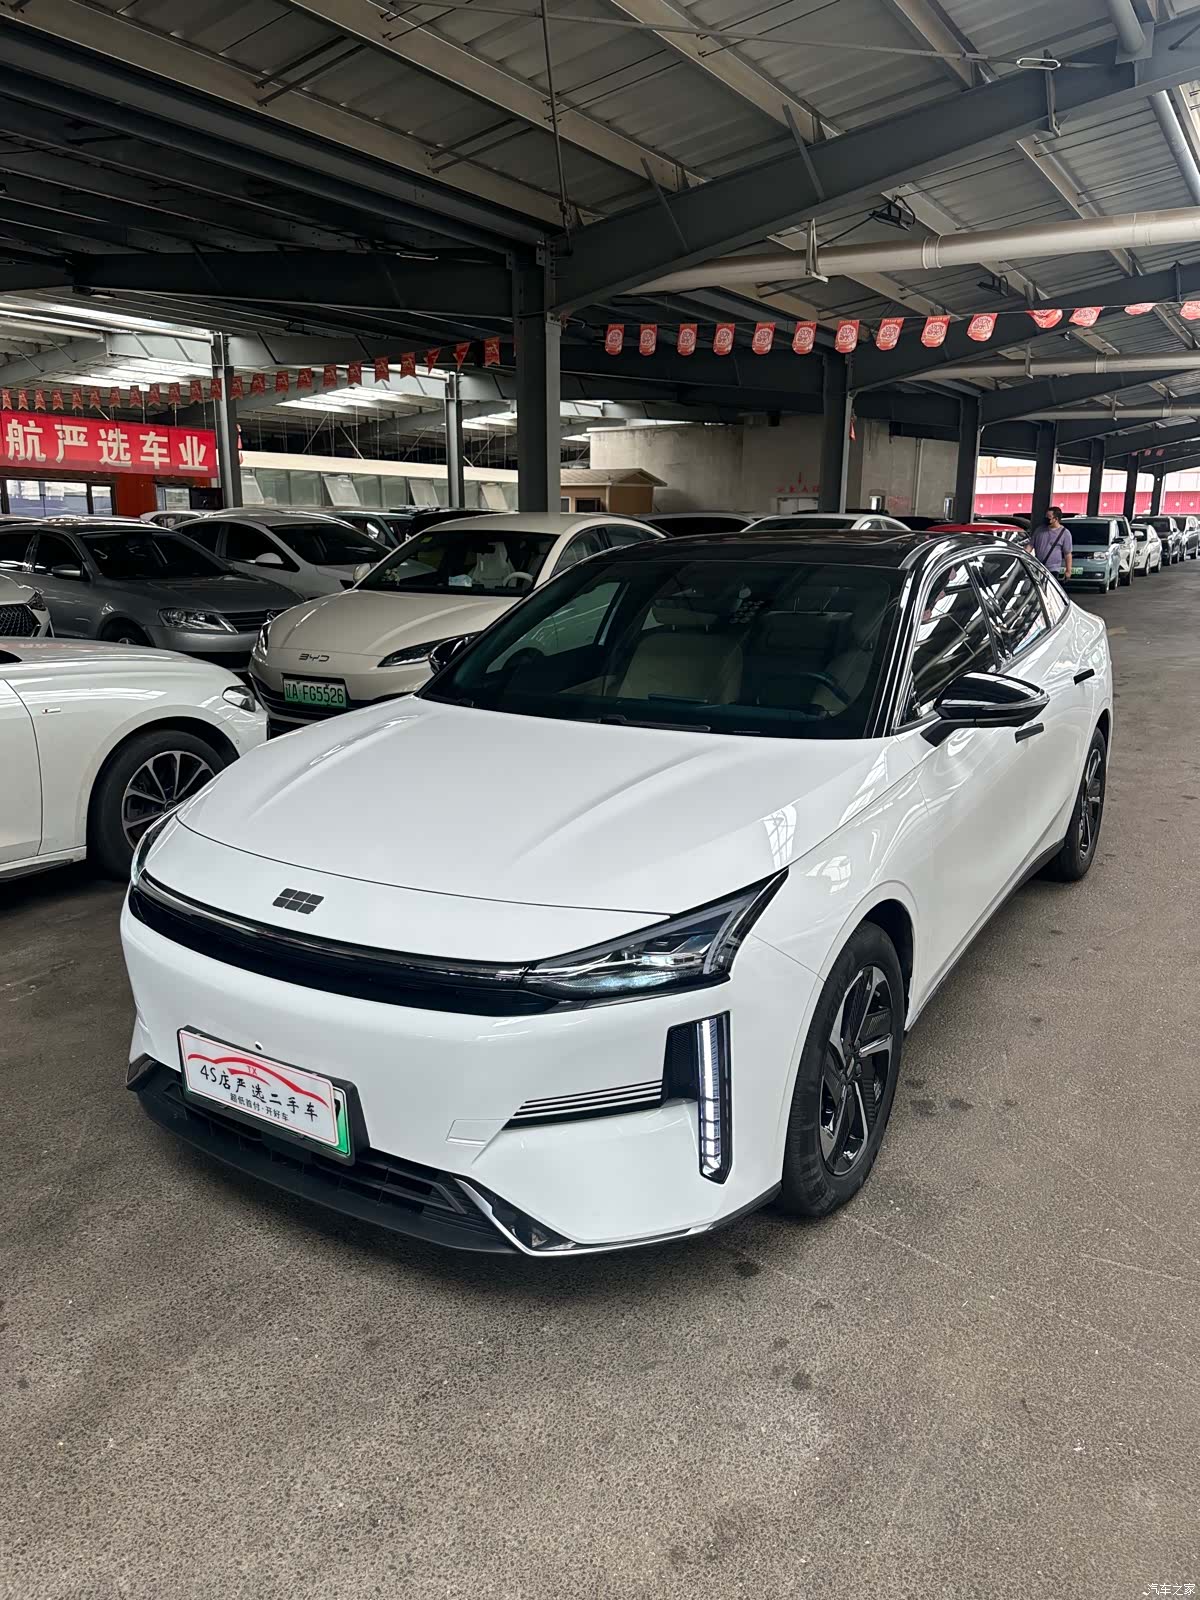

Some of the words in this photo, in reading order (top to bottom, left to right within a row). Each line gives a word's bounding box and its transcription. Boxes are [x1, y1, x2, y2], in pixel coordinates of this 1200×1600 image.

[6, 418, 209, 472] 航严选车业
[299, 653, 330, 662] BYD
[302, 685, 344, 704] FG5526
[200, 1064, 318, 1122] 4S店严选二手车
